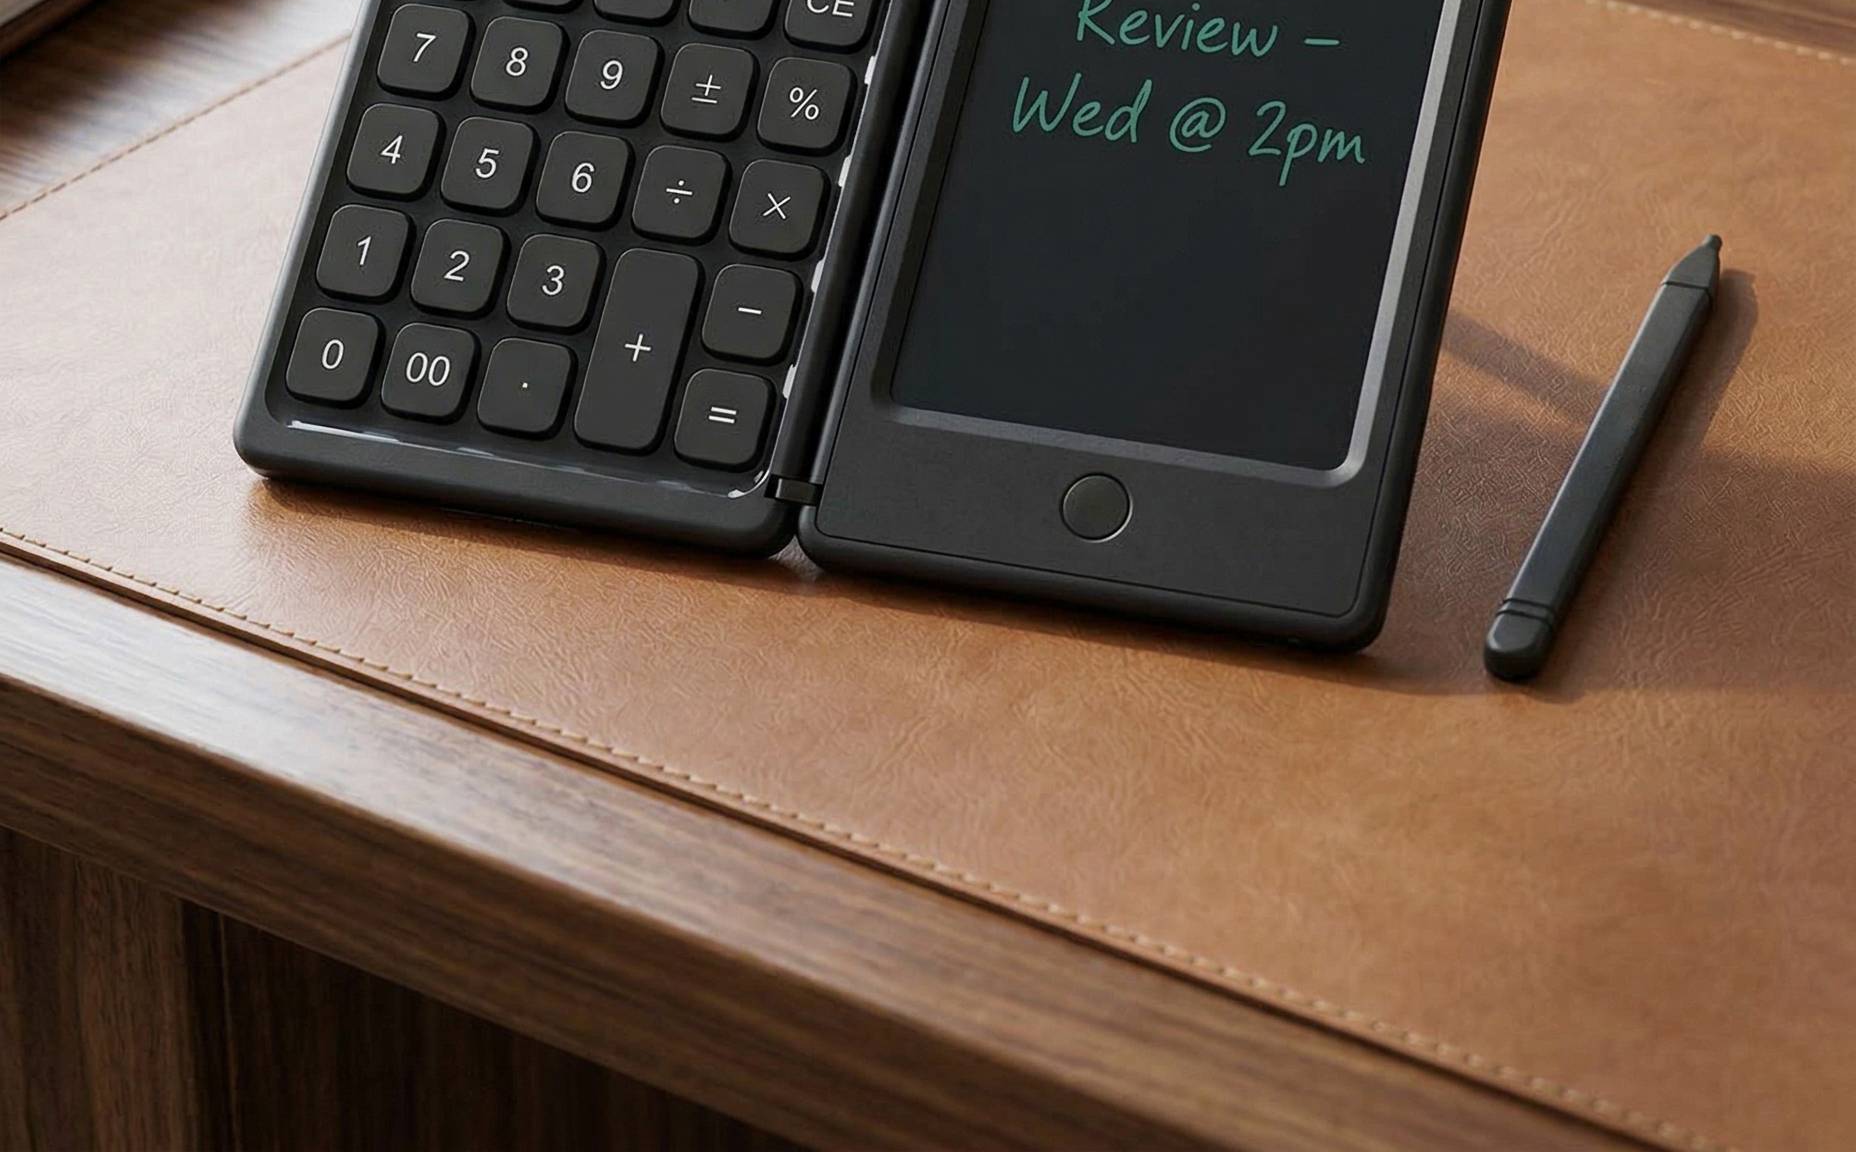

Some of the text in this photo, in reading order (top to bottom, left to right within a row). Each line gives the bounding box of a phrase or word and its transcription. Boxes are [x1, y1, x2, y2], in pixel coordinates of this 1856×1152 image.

[413, 32, 437, 62] 7
[505, 47, 529, 77] 8
[600, 60, 623, 90] 9
[788, 87, 820, 120] %
[1011, 72, 1366, 186] Wed @ 2pm
[380, 135, 403, 165] 4
[475, 147, 500, 179] 5
[571, 162, 595, 193] 6
[356, 236, 372, 266] 1
[444, 250, 470, 282] 2
[542, 265, 565, 296] 3
[321, 339, 344, 370] 0
[624, 333, 652, 362] +
[406, 352, 450, 386] 00
[708, 406, 737, 424] =
